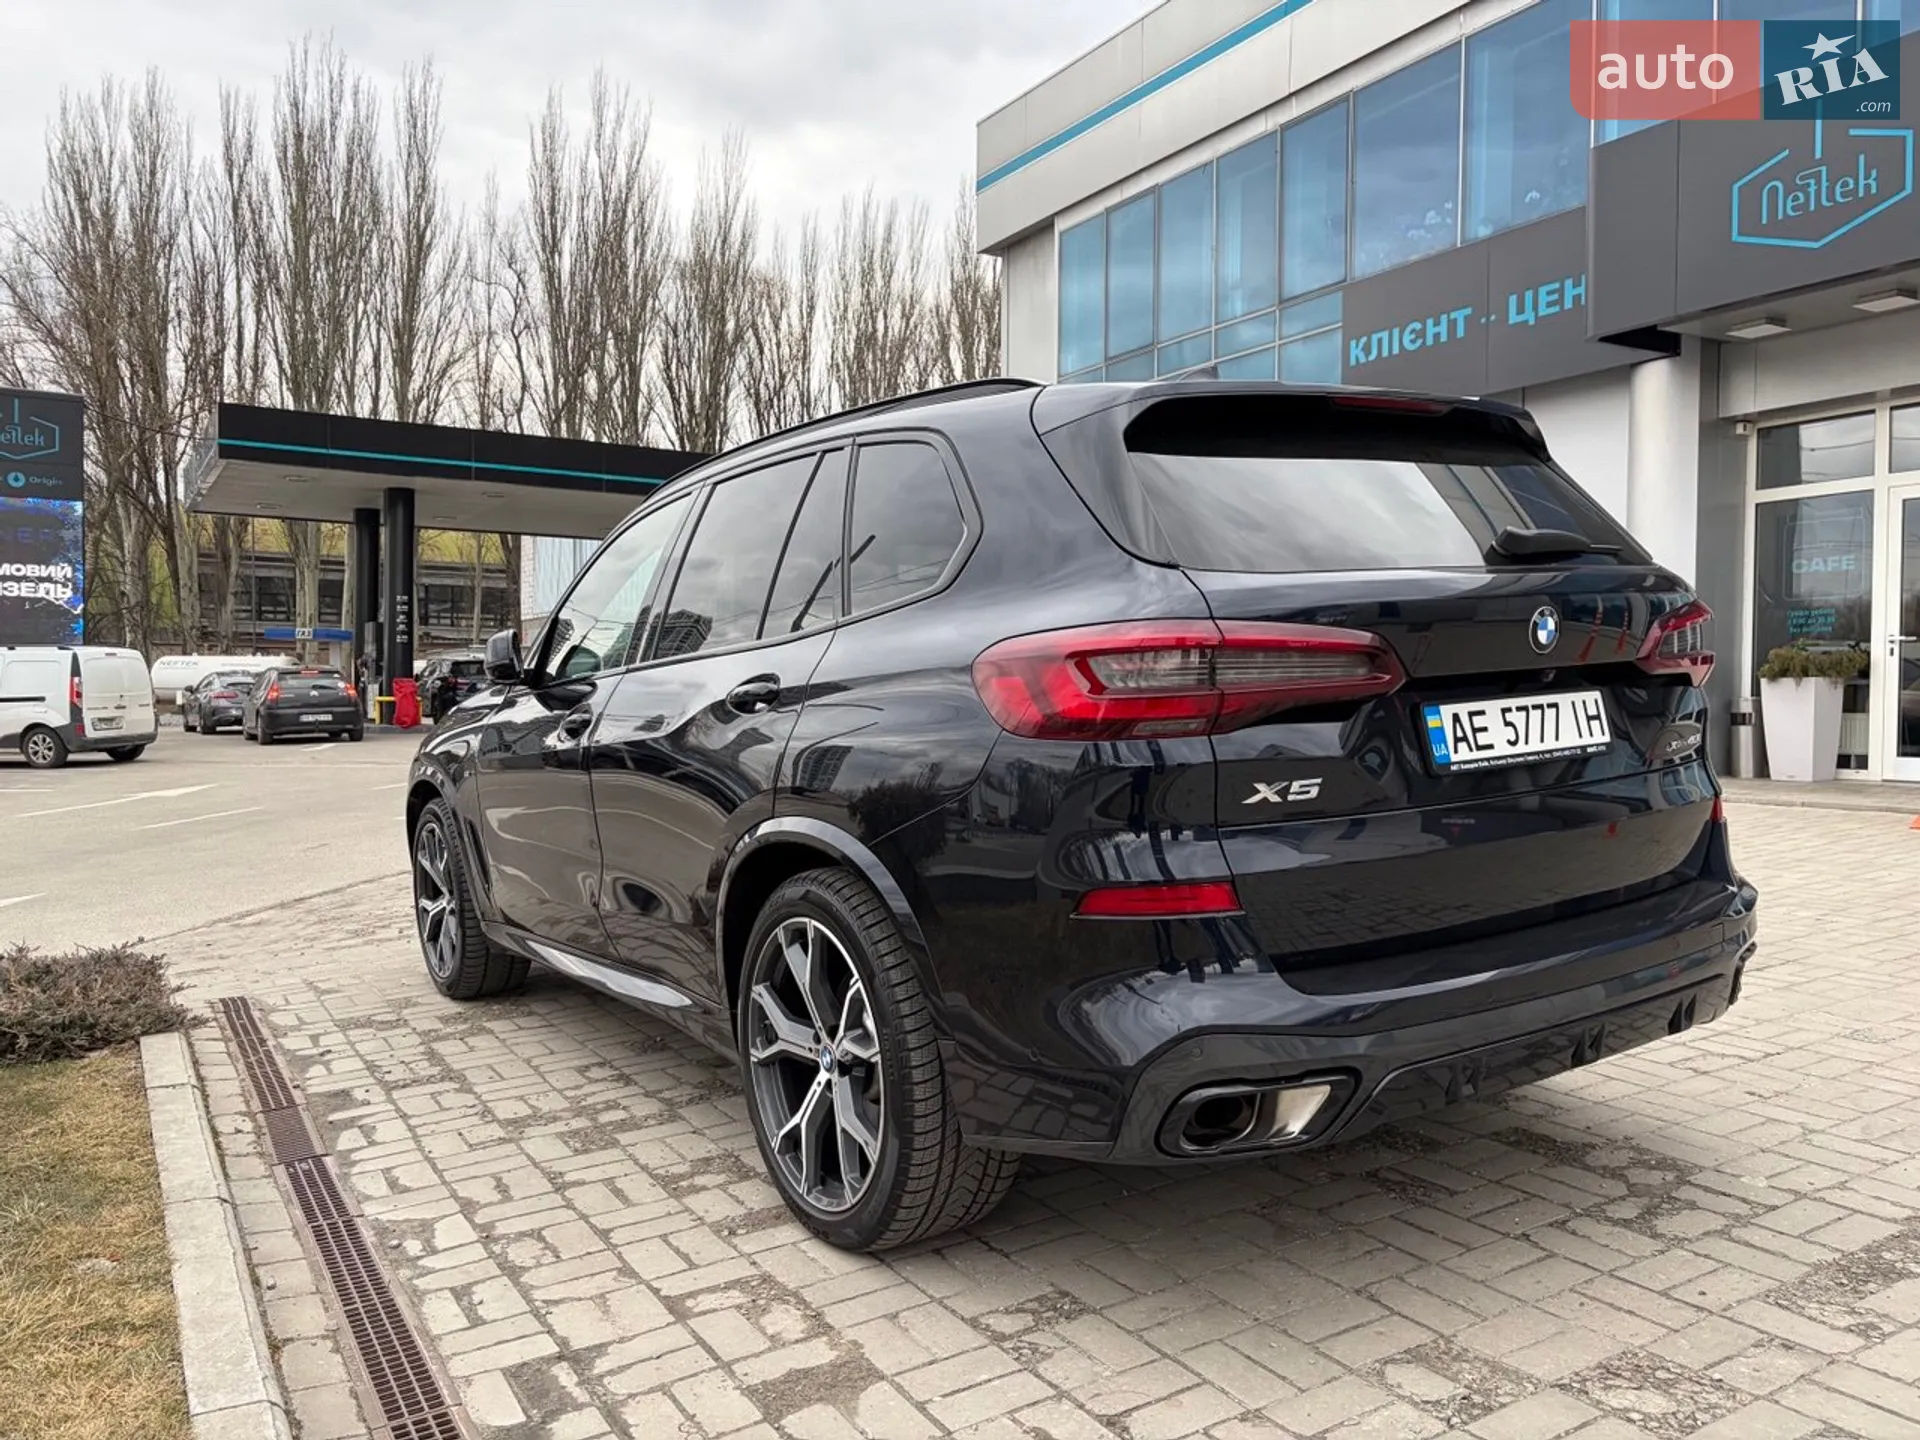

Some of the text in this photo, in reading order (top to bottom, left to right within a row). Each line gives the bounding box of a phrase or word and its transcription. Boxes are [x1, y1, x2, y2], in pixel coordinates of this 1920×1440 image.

[1349, 306, 1473, 367] КЛІЄНТ
[1792, 554, 1856, 574] CAFE
[1451, 708, 1495, 755] AE
[1500, 701, 1560, 748] 5777
[1432, 743, 1449, 756] UA
[1240, 776, 1323, 805] X5
